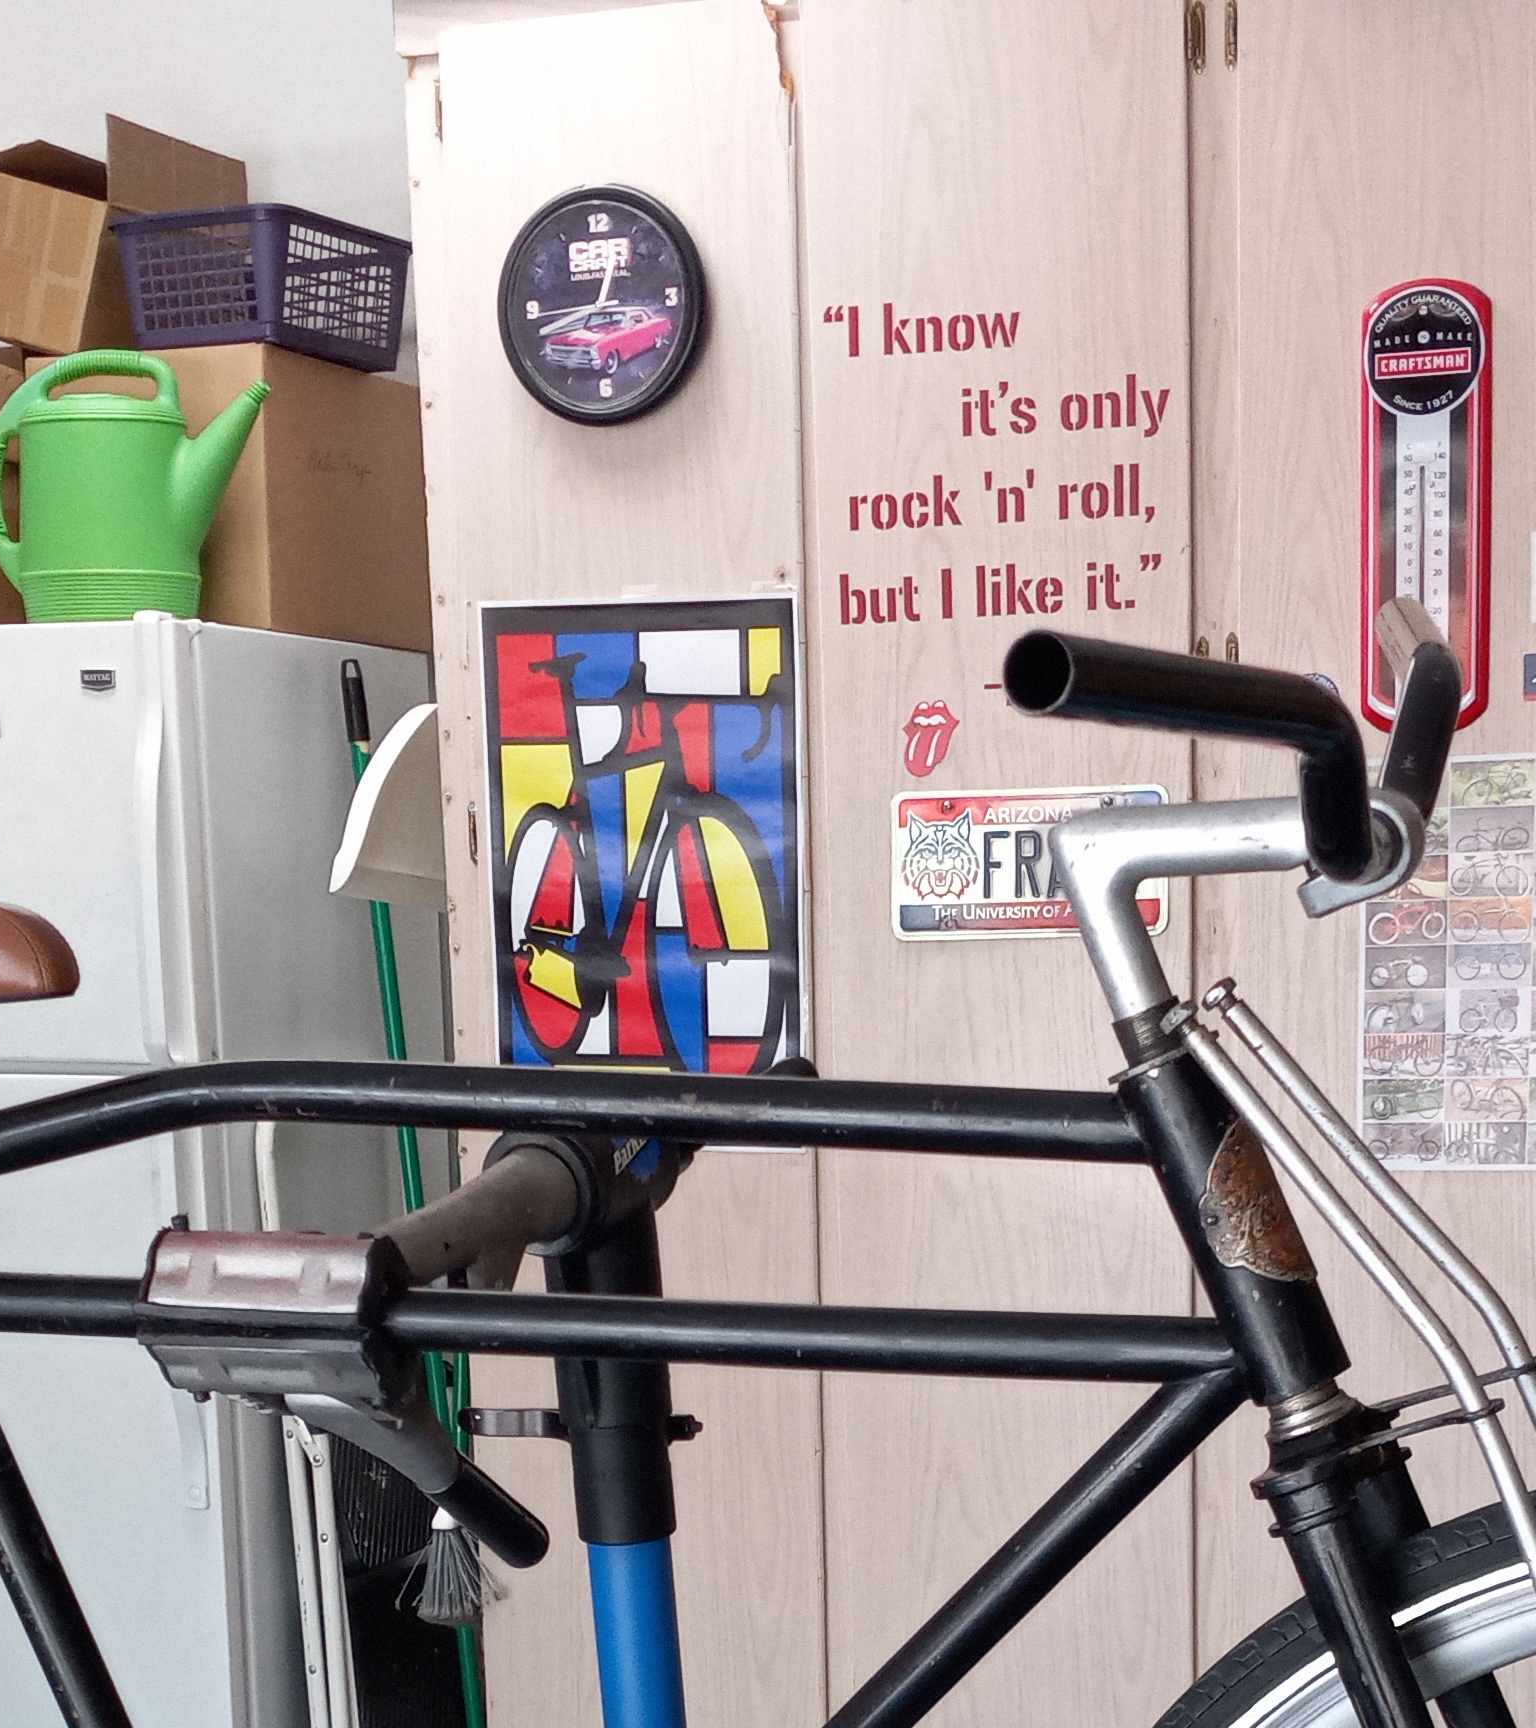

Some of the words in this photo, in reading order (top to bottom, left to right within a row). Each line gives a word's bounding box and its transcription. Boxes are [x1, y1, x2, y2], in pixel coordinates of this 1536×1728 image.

[587, 213, 610, 234] 12
[568, 237, 629, 261] CAR
[665, 287, 678, 307] 3
[526, 301, 539, 320] 9
[1374, 298, 1410, 333] QUALITY
[1410, 294, 1472, 326] GUARANTEED
[883, 302, 1020, 355] know
[1373, 335, 1411, 349] MADE
[1435, 331, 1473, 341] MAKE
[1380, 354, 1466, 373] CRAFTSMAN
[599, 378, 613, 397] 6
[1060, 374, 1171, 438] only
[1393, 394, 1423, 411] SINCE
[1426, 389, 1454, 410] 1927
[1434, 471, 1447, 480] 120
[849, 474, 962, 532] rock
[1058, 463, 1156, 524] roll,
[1434, 490, 1447, 499] 100
[1403, 524, 1413, 533] 20
[1404, 542, 1413, 550] 10
[1432, 568, 1443, 577] 20
[839, 574, 921, 625] but
[941, 568, 954, 620] I
[976, 563, 1065, 618] like
[1433, 588, 1438, 596] 0
[983, 806, 1074, 825] ARIZONA
